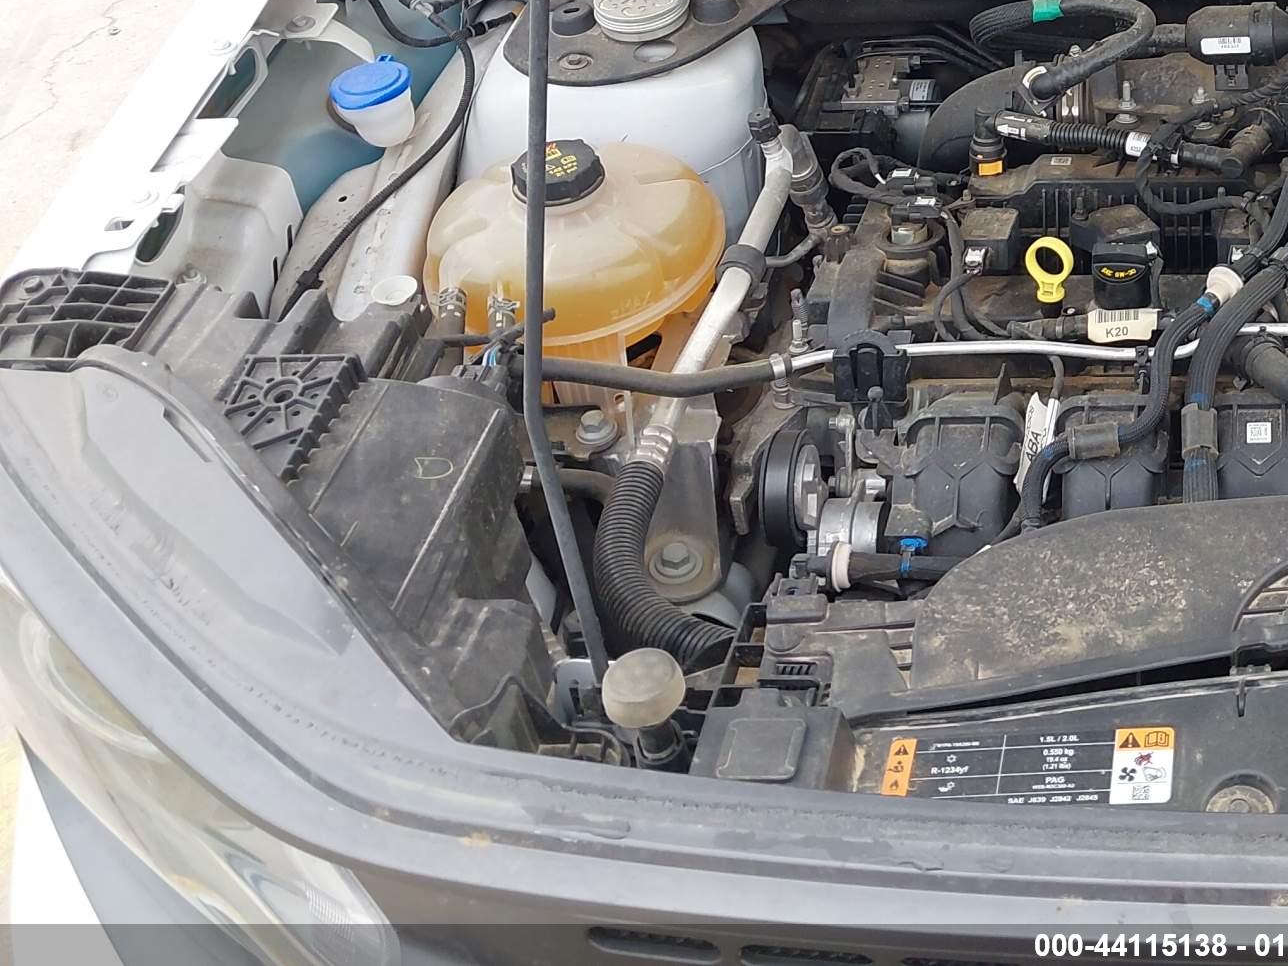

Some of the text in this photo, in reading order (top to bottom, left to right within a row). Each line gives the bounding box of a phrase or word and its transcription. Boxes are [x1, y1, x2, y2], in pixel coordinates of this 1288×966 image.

[1105, 326, 1129, 339] K20
[1026, 431, 1042, 463] ABA
[1062, 734, 1080, 742] 2.0L
[1064, 748, 1075, 757] kg
[930, 765, 969, 775] R-1234yf
[1044, 776, 1066, 784] PAG
